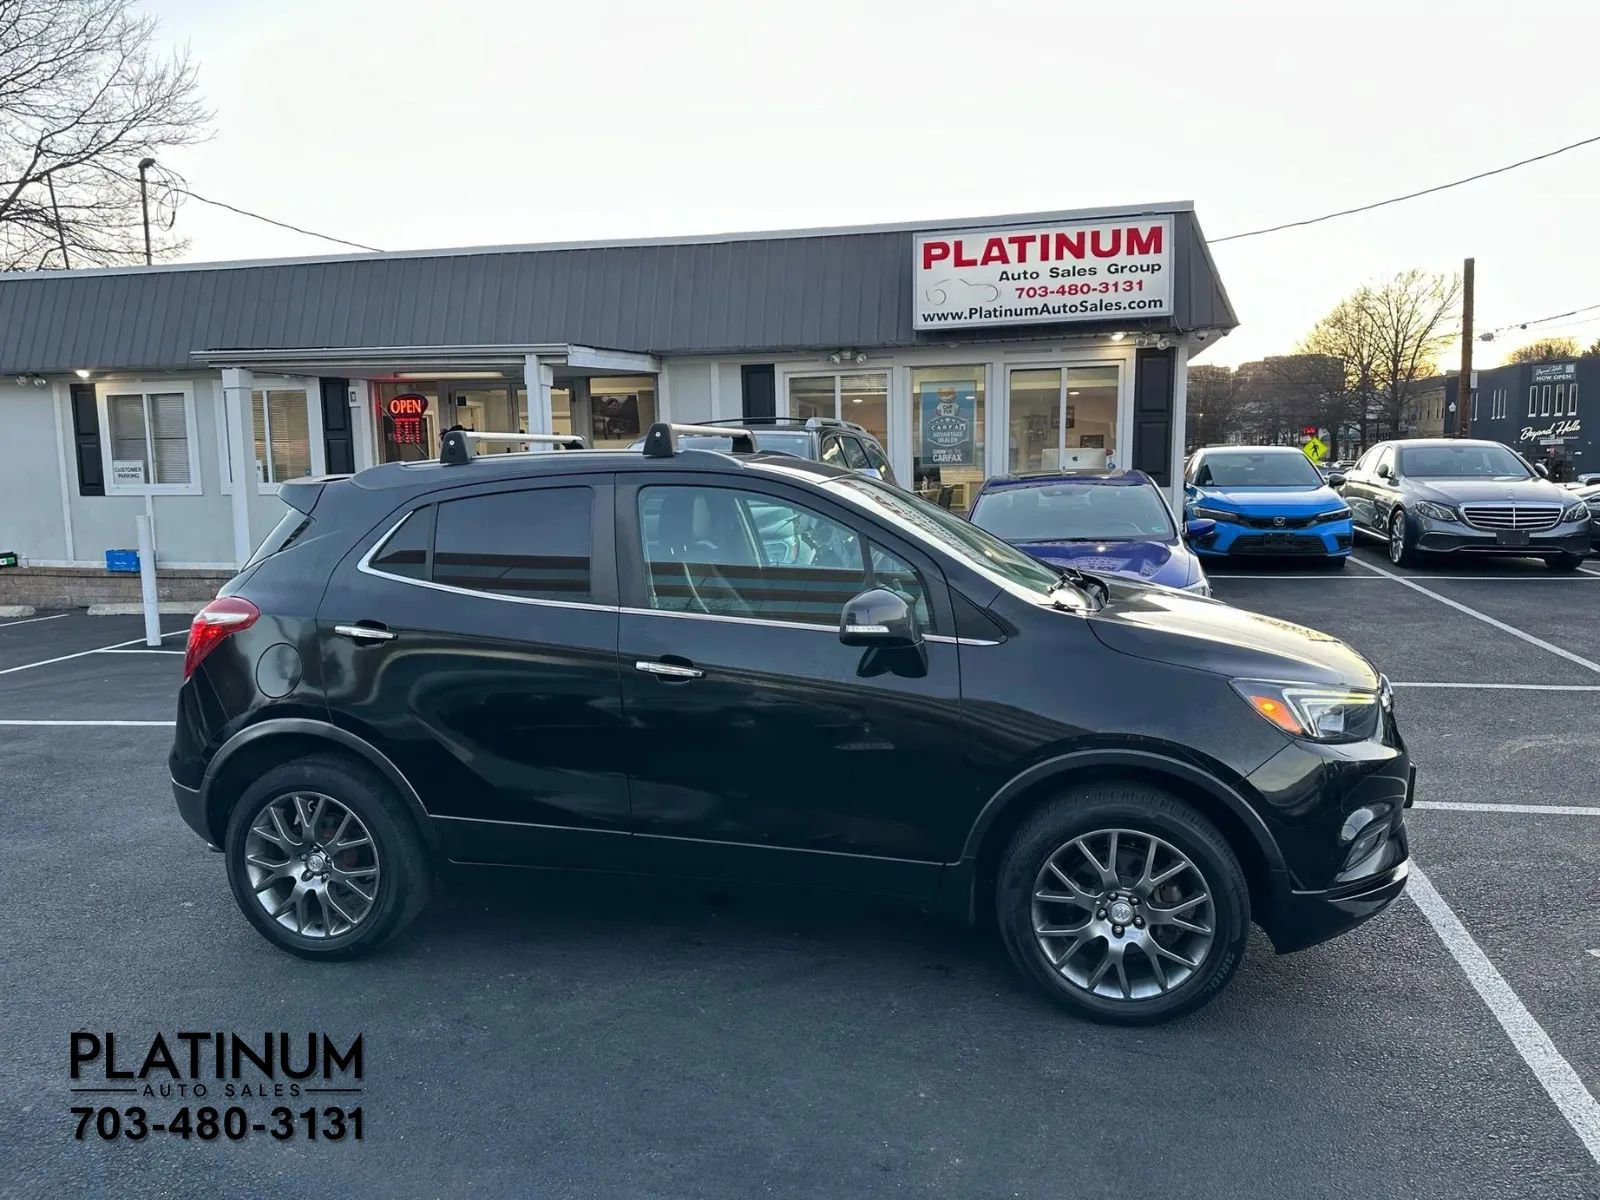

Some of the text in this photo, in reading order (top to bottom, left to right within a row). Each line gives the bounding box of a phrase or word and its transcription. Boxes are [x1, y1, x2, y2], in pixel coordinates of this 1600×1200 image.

[923, 225, 1163, 270] PLATINUM
[998, 261, 1162, 282] Auto Sales Group
[1015, 279, 1144, 299] 703-480-3131
[922, 297, 1163, 322] www.PlatinumAutoSales.com
[390, 399, 422, 414] OPEN
[1520, 420, 1581, 442] Beyond Hello
